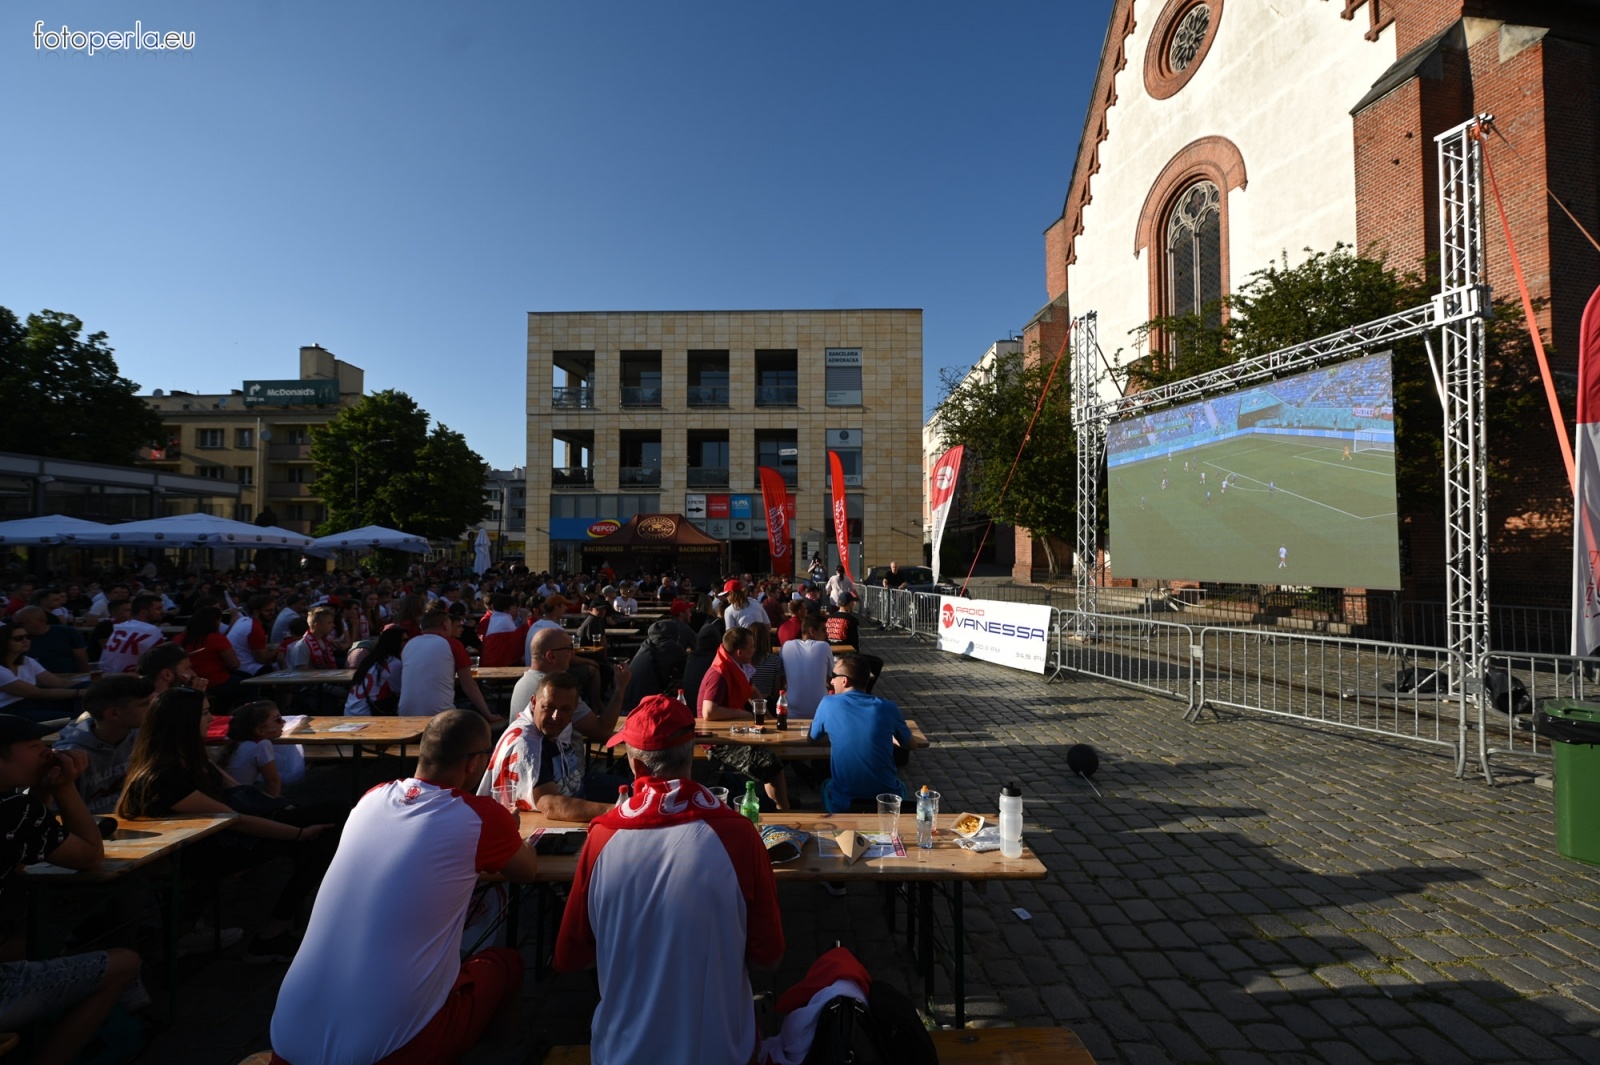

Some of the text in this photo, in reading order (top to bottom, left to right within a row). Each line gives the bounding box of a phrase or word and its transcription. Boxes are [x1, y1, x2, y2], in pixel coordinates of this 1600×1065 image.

[266, 388, 315, 397] McDonald's
[955, 607, 985, 616] RADIO
[955, 617, 1045, 642] VANESSA
